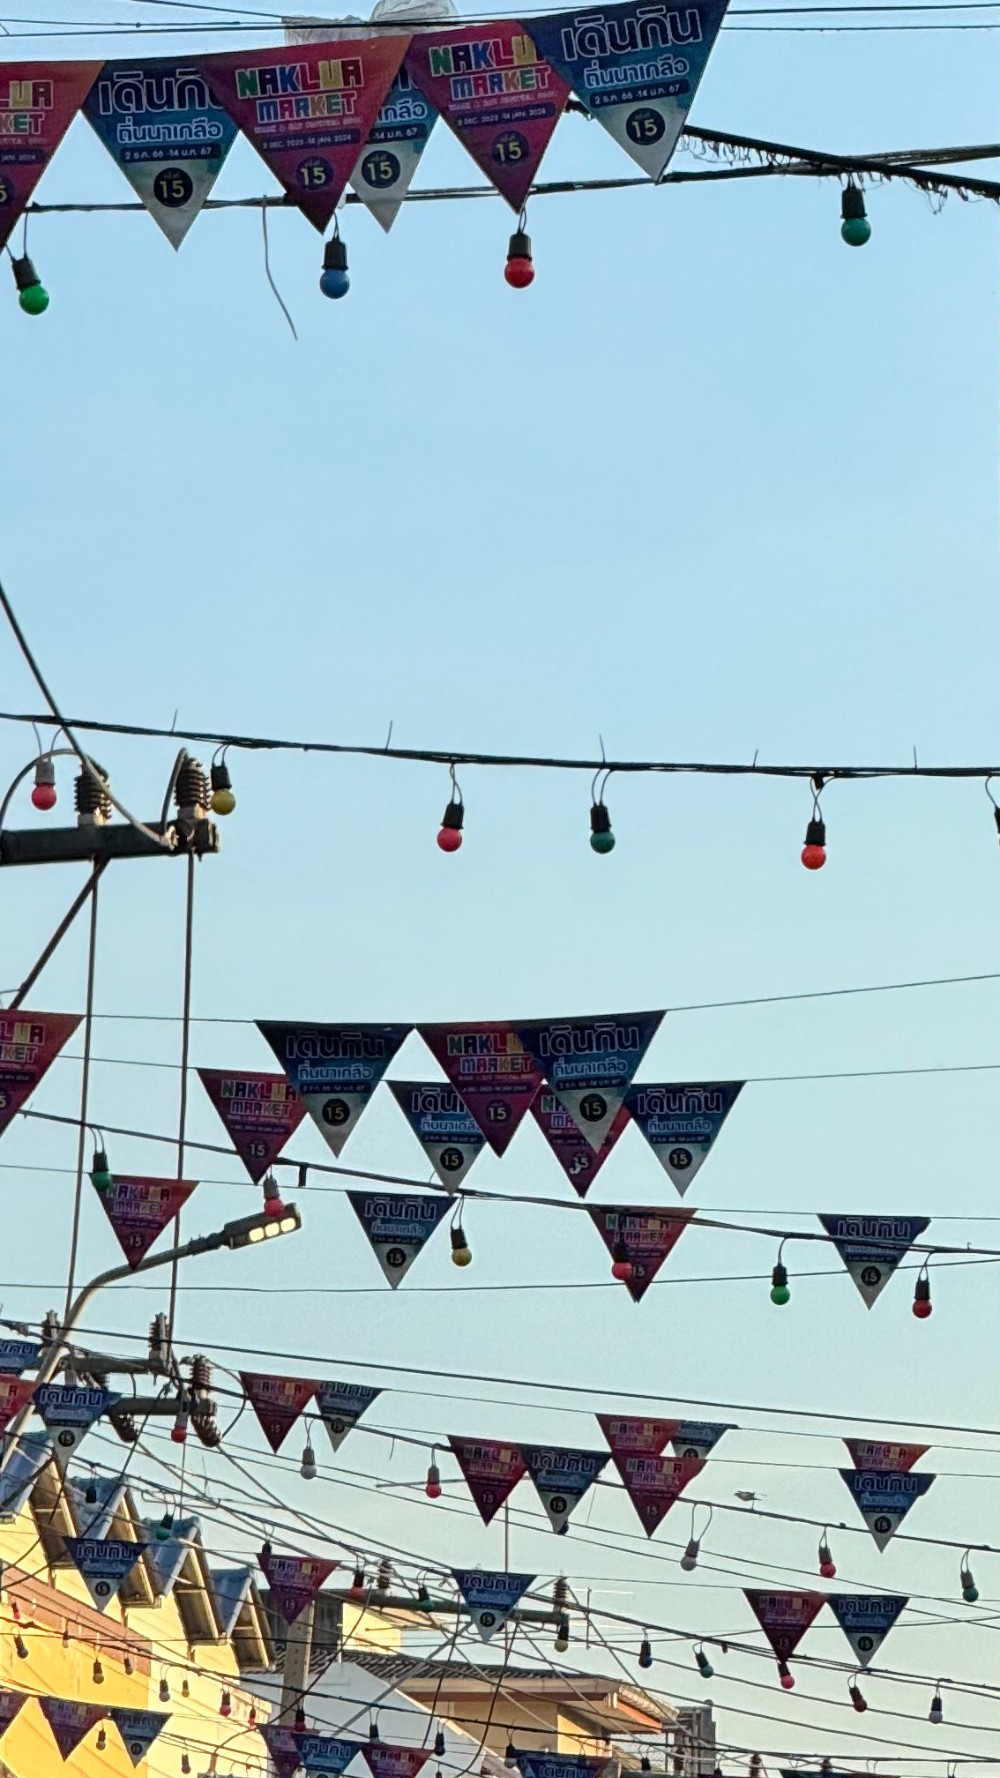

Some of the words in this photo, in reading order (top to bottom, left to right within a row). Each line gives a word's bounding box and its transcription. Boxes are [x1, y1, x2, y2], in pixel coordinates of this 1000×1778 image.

[561, 5, 702, 62] เดินกิน
[429, 35, 547, 78] NAKLU
[235, 57, 364, 99] NAKLUA
[583, 54, 689, 89] ถิ่นนาเกลือ
[451, 66, 551, 101] MARKET
[256, 91, 357, 123] MARKET
[117, 116, 223, 143] ถิ่นนาเกลือ
[632, 118, 657, 137] 15
[496, 143, 521, 163] 15
[300, 166, 326, 186] 15
[367, 161, 393, 181] 15
[159, 181, 185, 198] 15
[286, 1031, 384, 1059] เดินกิน
[447, 1033, 524, 1056] NAKLU
[540, 1023, 639, 1057] เดินกิน
[460, 1056, 534, 1073] MARKET
[230, 1100, 292, 1117] MARKET
[584, 1103, 601, 1116] 15
[638, 1088, 722, 1115] เดินกิน
[327, 1107, 344, 1120] 15
[489, 1107, 506, 1120] 15
[250, 1144, 266, 1156] 15
[672, 1154, 687, 1165] 15
[444, 1155, 459, 1166] 15
[365, 1197, 437, 1221] เดินกิน
[838, 1218, 910, 1239] เดินกิน
[129, 1234, 142, 1246] 15
[390, 1252, 402, 1262] 15
[633, 1267, 645, 1277] 15
[865, 1270, 877, 1282] 15
[532, 1451, 596, 1472] เดินกิน
[854, 1473, 917, 1492] เดินกิน
